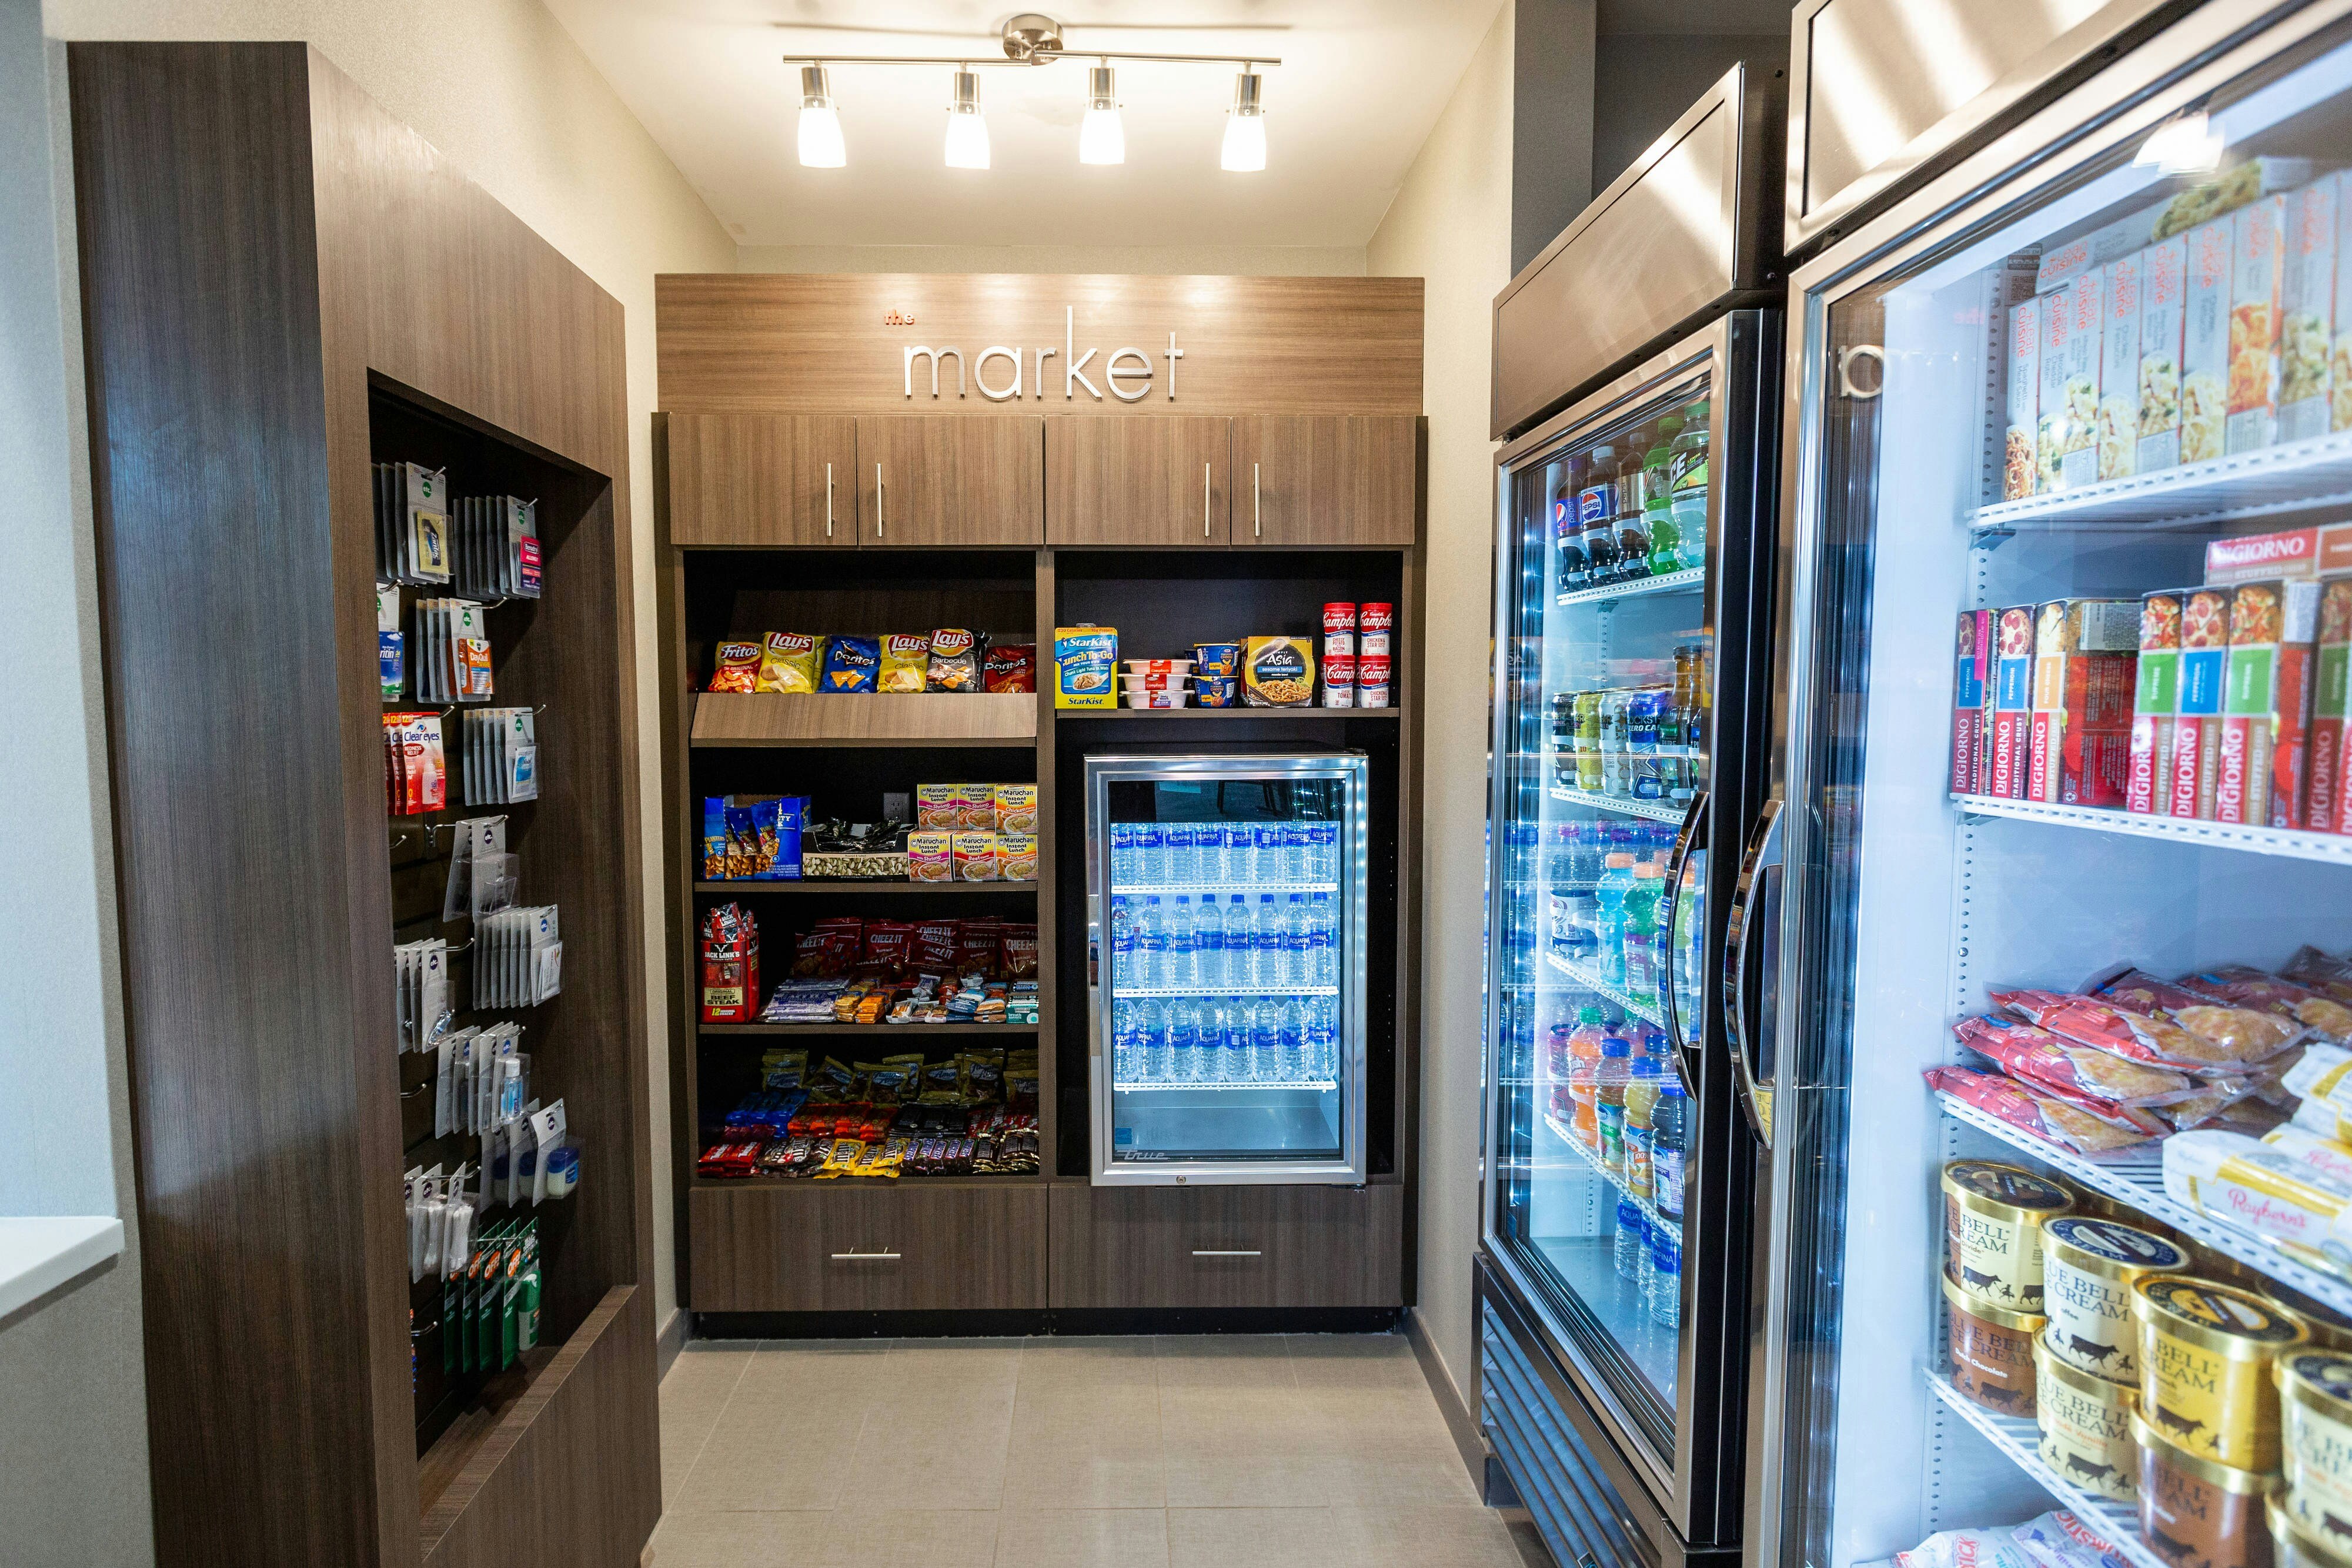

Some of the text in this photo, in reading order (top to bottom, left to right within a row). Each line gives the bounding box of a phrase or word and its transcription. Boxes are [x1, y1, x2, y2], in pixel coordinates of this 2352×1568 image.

[2039, 250, 2087, 279] cuisine
[2154, 245, 2168, 305] cuisine
[2077, 275, 2087, 330] cuisine
[2117, 261, 2126, 318] cuisine
[884, 309, 915, 326] the
[2052, 294, 2062, 347] cuisine
[2017, 306, 2026, 358] cuisine
[903, 305, 1184, 402] market
[721, 644, 759, 658] Fritos
[770, 632, 811, 650] Lay's
[891, 635, 928, 651] Lay's
[931, 630, 970, 648] Lay's
[1069, 637, 1113, 647] StarKist
[470, 653, 489, 664] DayQuil
[770, 657, 801, 670] Classic
[834, 650, 875, 666] Doritos
[894, 662, 924, 671] Classic
[931, 657, 967, 665] Barbecue
[985, 657, 1027, 671] Doritos
[1267, 654, 1293, 666] Asia
[404, 731, 439, 743] Clear eyes
[1956, 717, 1970, 788] DIGIORNO
[1995, 720, 2010, 794] DIGIORNO
[2033, 721, 2046, 798] DIGIORNO
[2013, 744, 2022, 800] TRADITIONAL
[2177, 727, 2197, 817] DIGIORNO
[2223, 728, 2244, 822] DIGIORNO
[711, 1008, 721, 1016] 12
[1962, 1213, 2010, 1241] BELL
[2054, 1281, 2128, 1322] CREAM
[1971, 1355, 2009, 1379] Chocolate
[2051, 1398, 2126, 1442] CREAM
[2072, 1395, 2129, 1427] BELL
